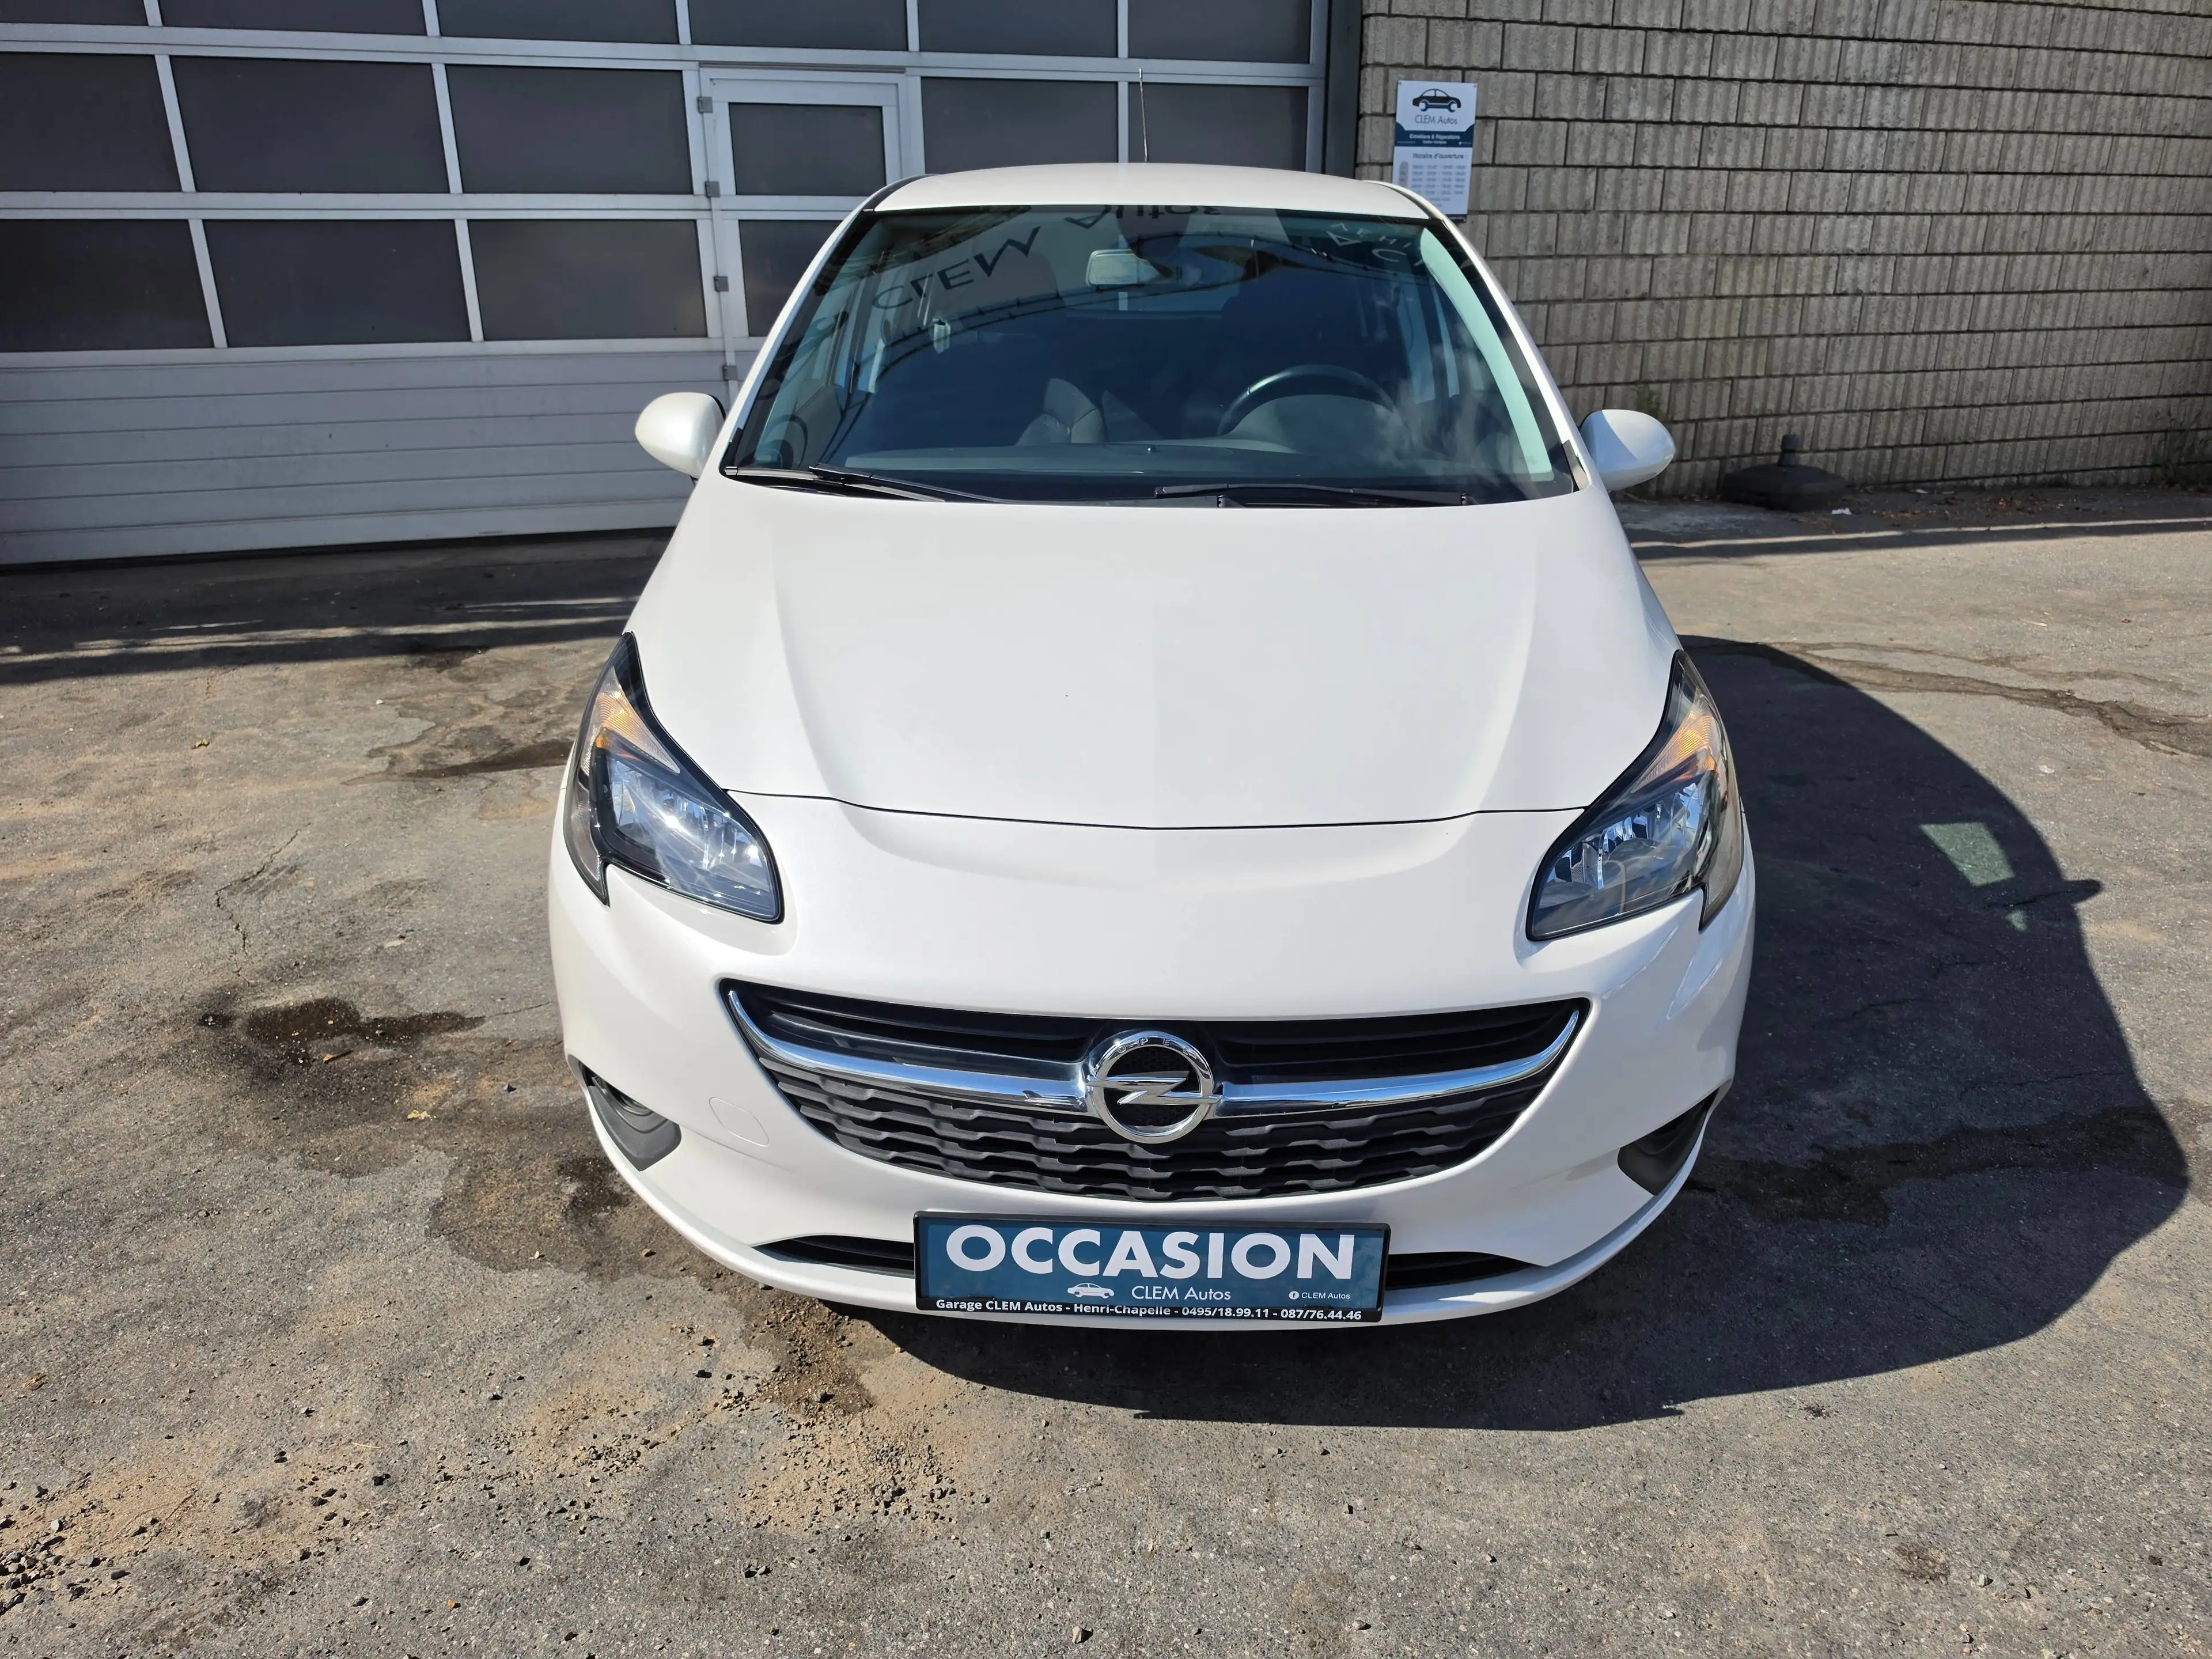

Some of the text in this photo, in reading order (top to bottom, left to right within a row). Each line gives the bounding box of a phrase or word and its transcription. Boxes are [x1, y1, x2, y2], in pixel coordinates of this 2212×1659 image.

[1415, 114, 1458, 124] CLEM Autos
[1117, 1037, 1190, 1056] OPEL
[946, 1224, 1355, 1279] OCCASION
[1131, 1285, 1231, 1301] CLEM Autos
[936, 1299, 982, 1312] Garage
[986, 1300, 1021, 1311] CLEM
[1024, 1301, 1063, 1312] Autos
[1074, 1304, 1171, 1317] Henri-Chapelle
[1181, 1307, 1268, 1319] 0495/18.99.11
[1281, 1309, 1362, 1320] 087/76.44.46
